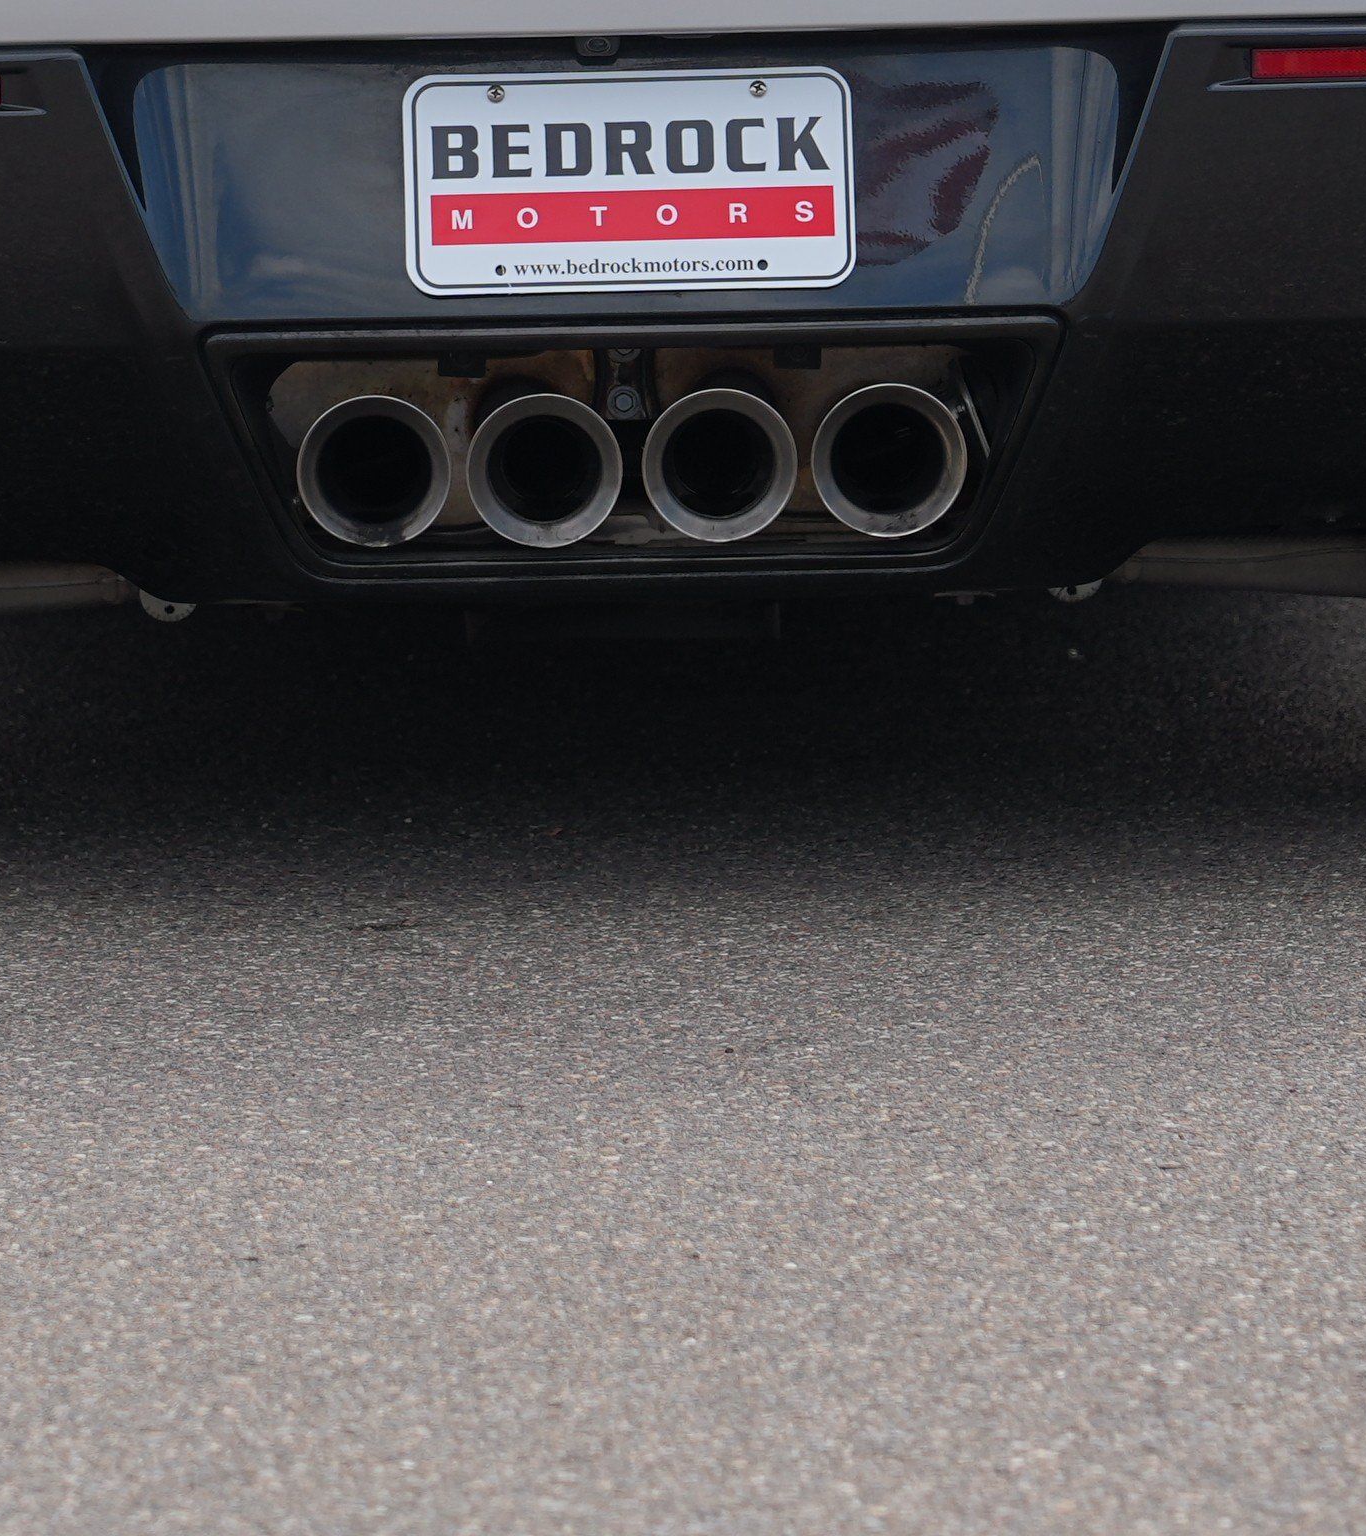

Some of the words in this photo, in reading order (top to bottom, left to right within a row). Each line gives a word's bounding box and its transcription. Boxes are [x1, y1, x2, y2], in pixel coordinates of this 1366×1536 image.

[431, 116, 831, 180] BEDROCK
[451, 200, 815, 231] MOTORS
[514, 257, 755, 277] www.bedrockmotors.com
